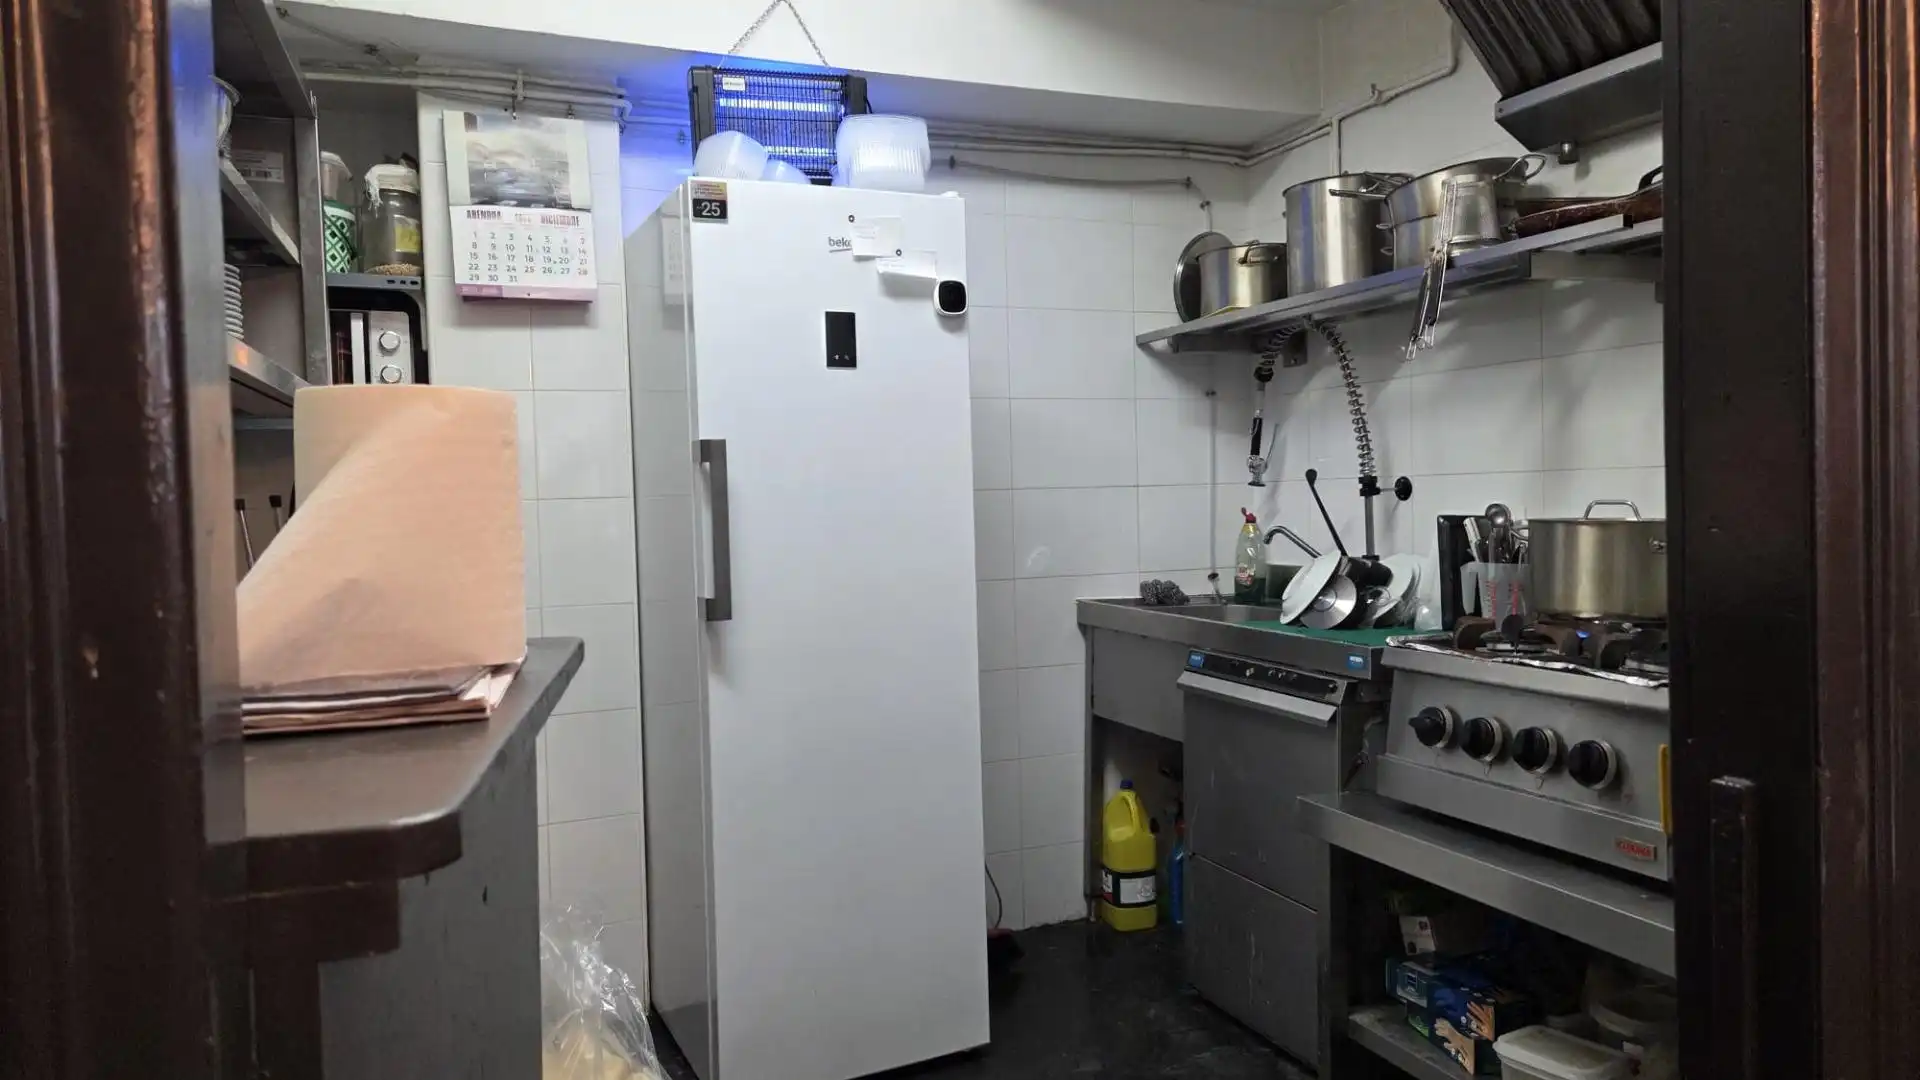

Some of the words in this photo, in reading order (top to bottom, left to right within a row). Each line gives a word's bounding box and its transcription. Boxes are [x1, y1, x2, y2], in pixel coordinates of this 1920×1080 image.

[701, 202, 721, 217] 25
[505, 244, 515, 252] 10
[526, 245, 533, 253] 11
[542, 245, 551, 254] 12
[469, 252, 479, 260] 15
[488, 253, 498, 261] 16
[506, 254, 516, 262] 17
[525, 254, 534, 263] 18
[543, 256, 552, 264] 19
[559, 257, 570, 265] 20
[468, 263, 479, 271] 22
[487, 263, 498, 272] 23
[506, 265, 517, 273] 24
[524, 265, 535, 274] 25
[542, 267, 552, 275] 26
[560, 267, 570, 275] 27
[469, 273, 479, 281] 29
[487, 273, 499, 282] 30
[508, 275, 518, 283] 31
